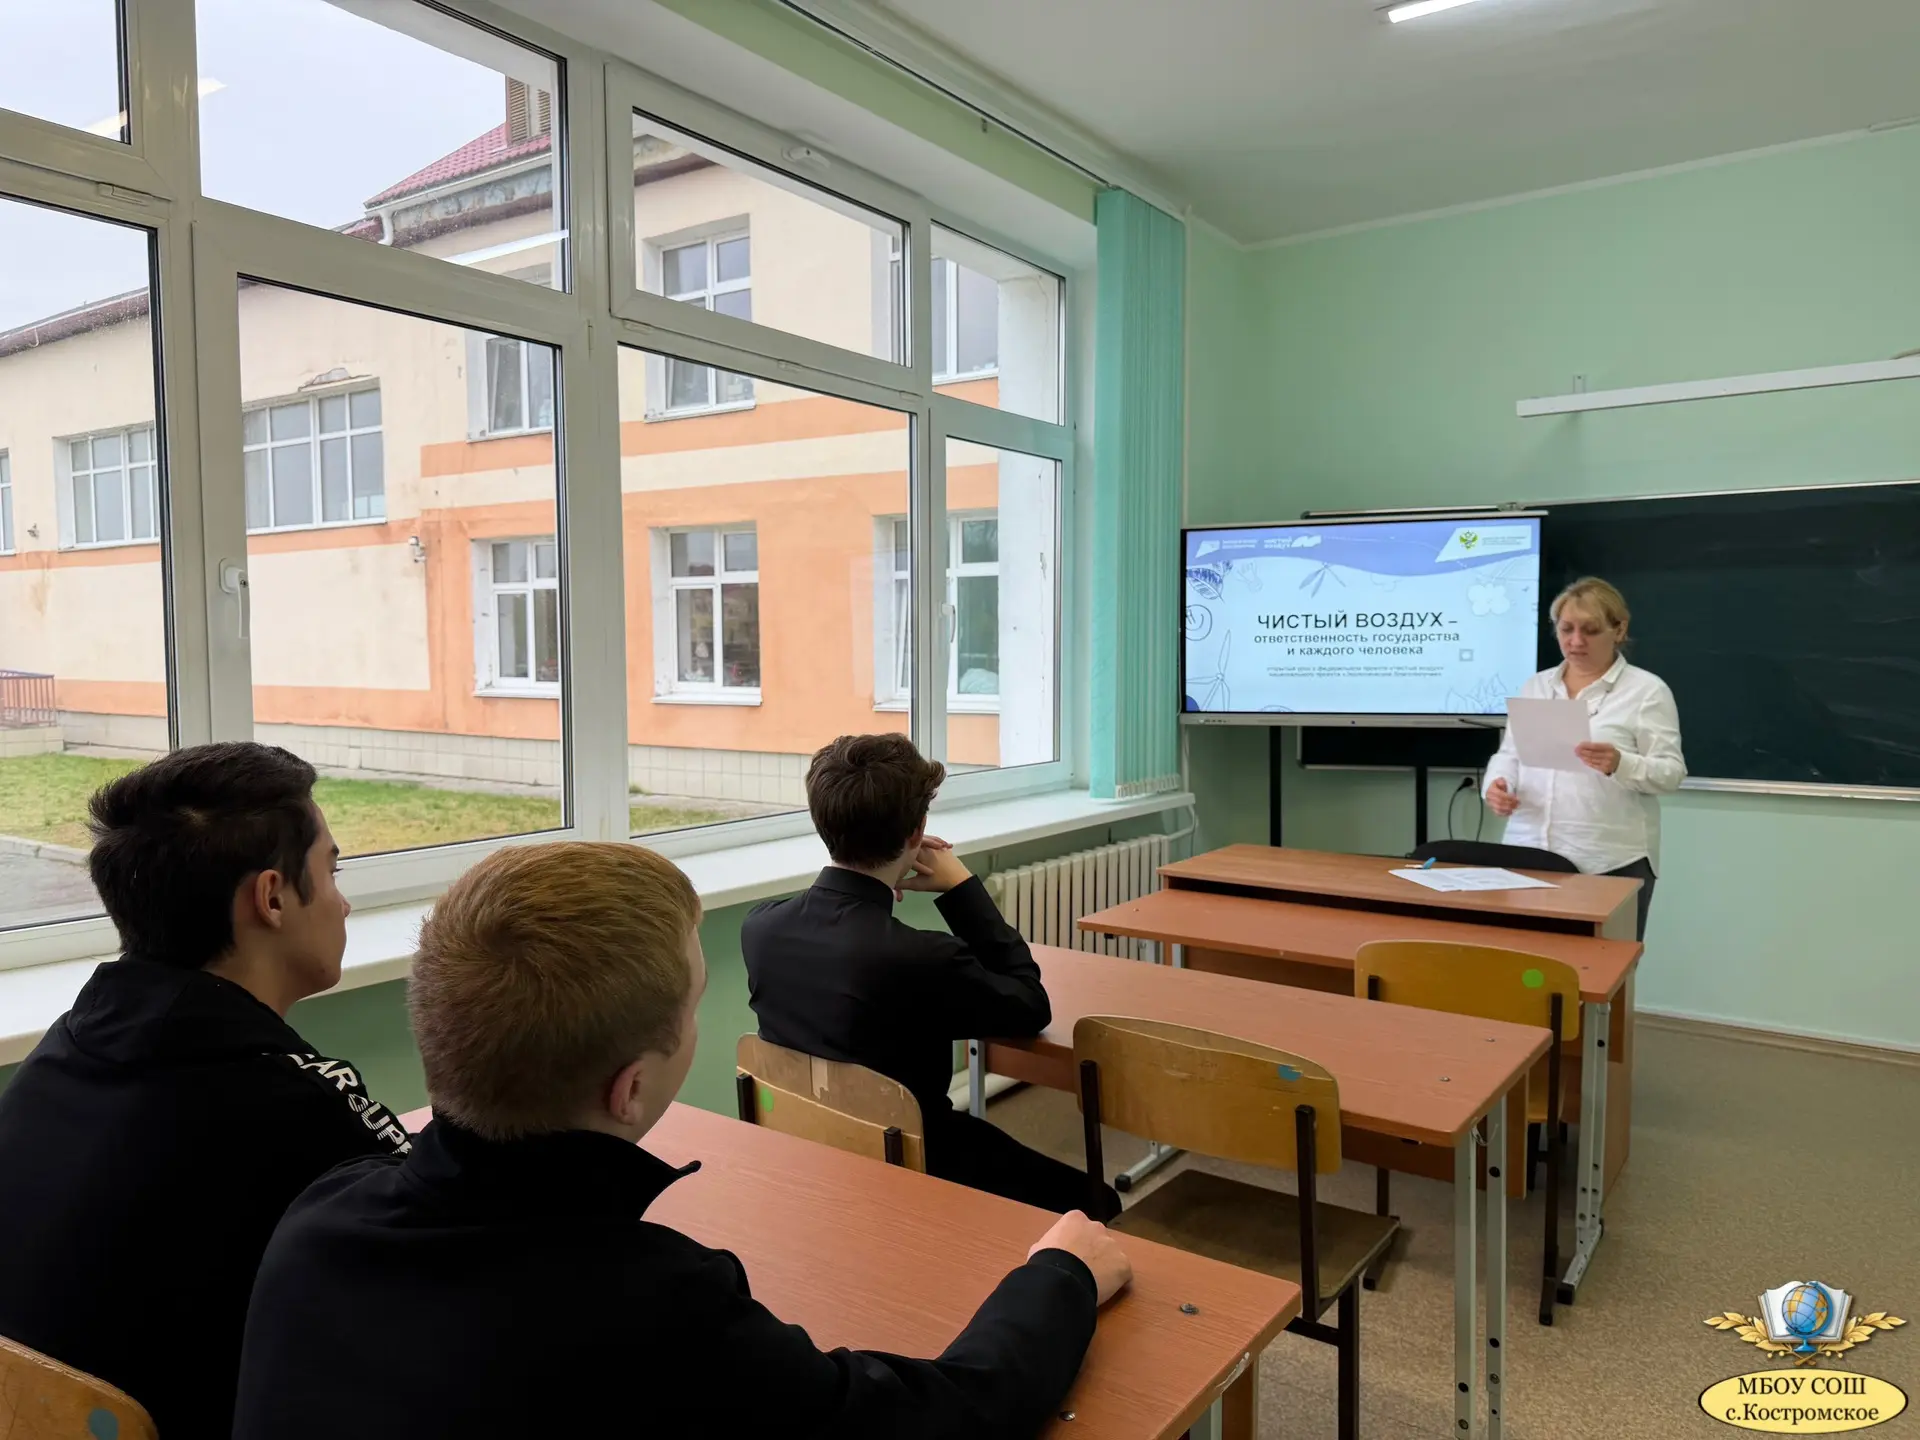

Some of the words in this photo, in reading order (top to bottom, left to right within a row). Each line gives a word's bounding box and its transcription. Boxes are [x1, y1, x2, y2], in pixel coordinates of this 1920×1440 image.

[1257, 609, 1348, 629] ЧИСТЫЙ
[1355, 611, 1443, 630] ВОЗДУХ
[1253, 634, 1369, 644] ответственность
[1372, 632, 1460, 645] государства
[1287, 648, 1295, 656] и
[1299, 647, 1355, 657] каждого
[1358, 646, 1424, 655] человека
